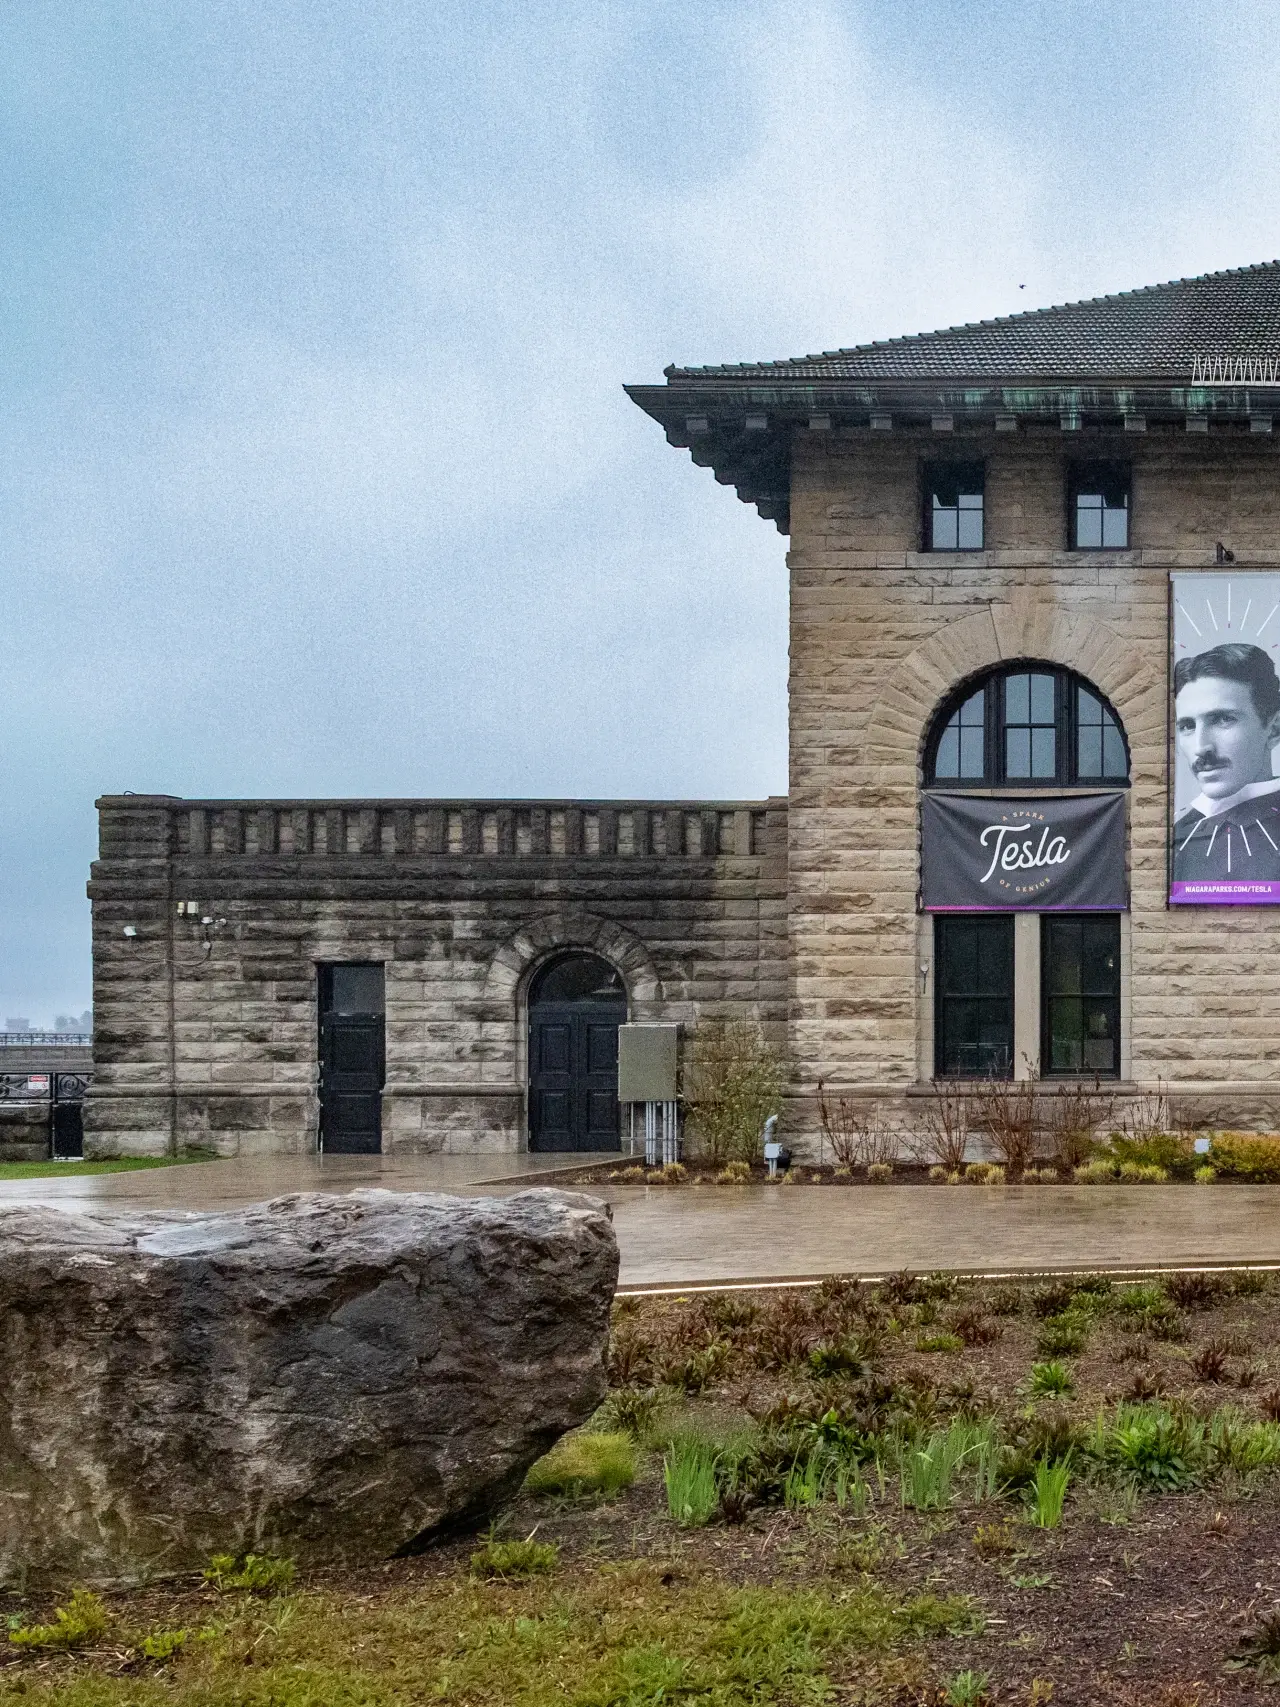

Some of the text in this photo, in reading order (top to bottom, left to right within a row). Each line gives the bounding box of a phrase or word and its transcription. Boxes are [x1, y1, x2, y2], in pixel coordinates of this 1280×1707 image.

[1012, 811, 1044, 820] SPARK
[980, 823, 1071, 883] Tesla
[1015, 877, 1050, 892] GENIUS
[1185, 885, 1272, 893] NIAGARAPARKS.COM/TESLA
